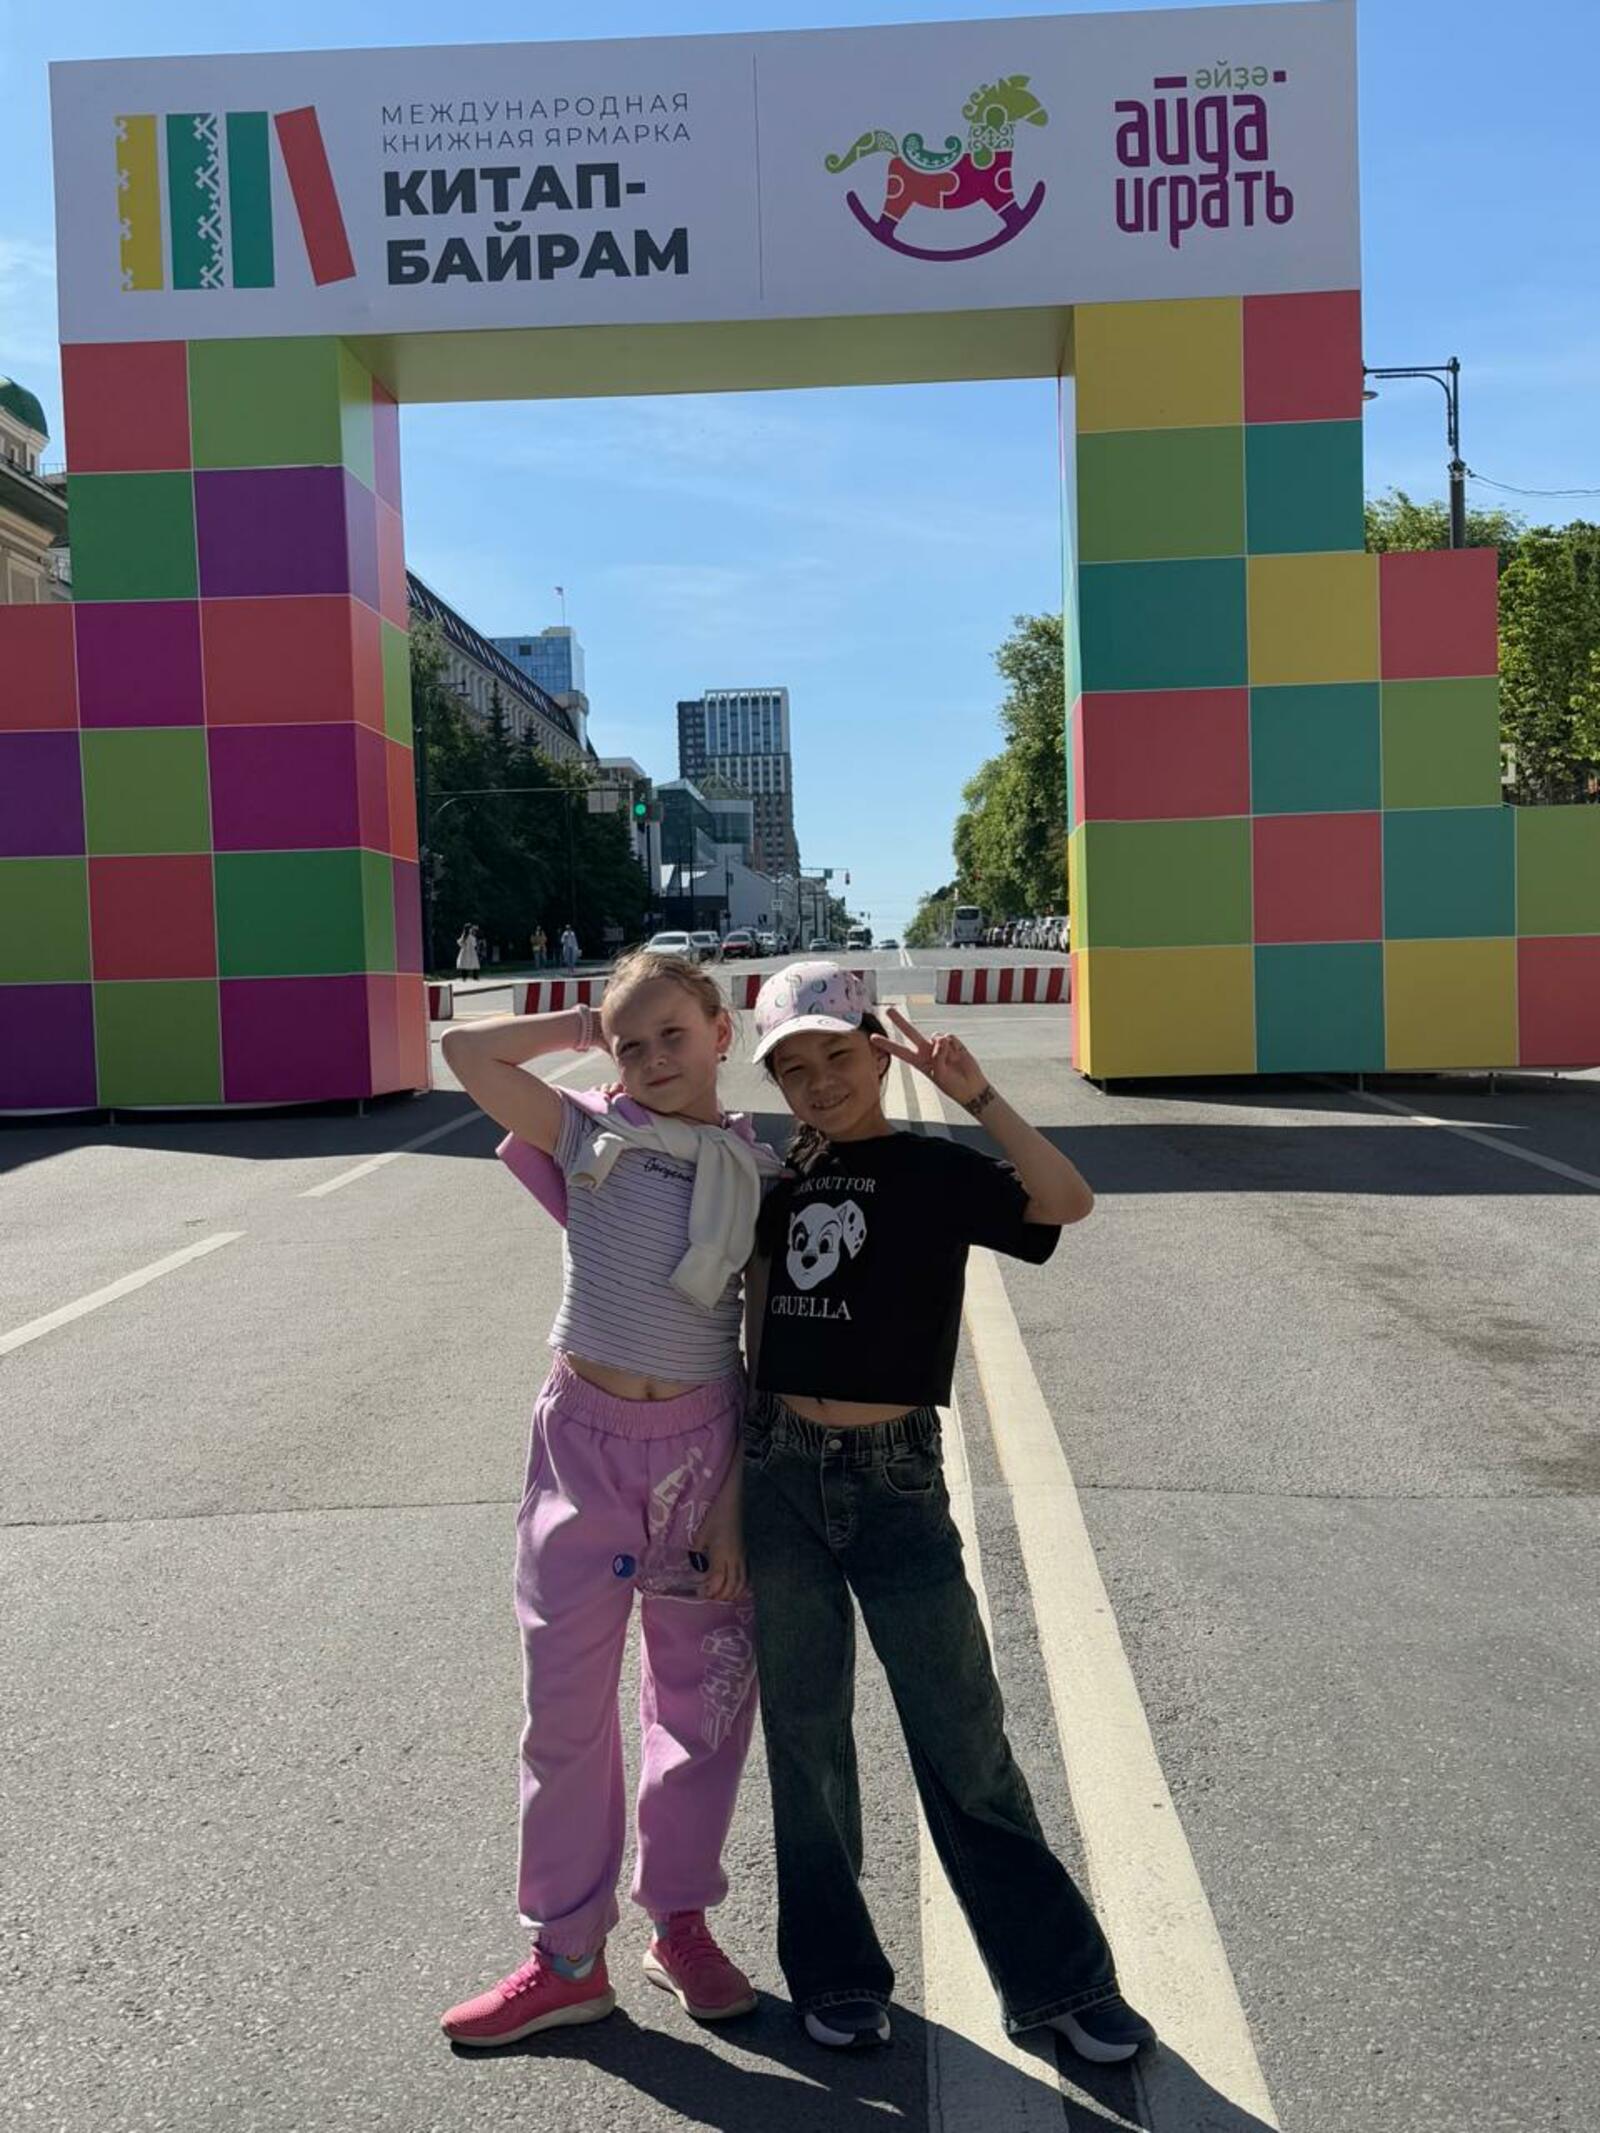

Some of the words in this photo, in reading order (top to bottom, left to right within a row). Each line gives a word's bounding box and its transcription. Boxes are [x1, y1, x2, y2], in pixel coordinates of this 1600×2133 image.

[381, 92, 689, 126] МЕЖДУНАРОДНАЯ
[382, 128, 534, 154] КНИЖНАЯ
[545, 122, 691, 148] ЯРМАРКА
[384, 162, 646, 217] КИТАП-
[1115, 169, 1294, 249] играть
[386, 219, 690, 285] БАЙРАМ
[816, 1175, 846, 1191] OUT
[846, 1177, 877, 1193] FOR
[771, 1295, 852, 1320] CRUELLA
